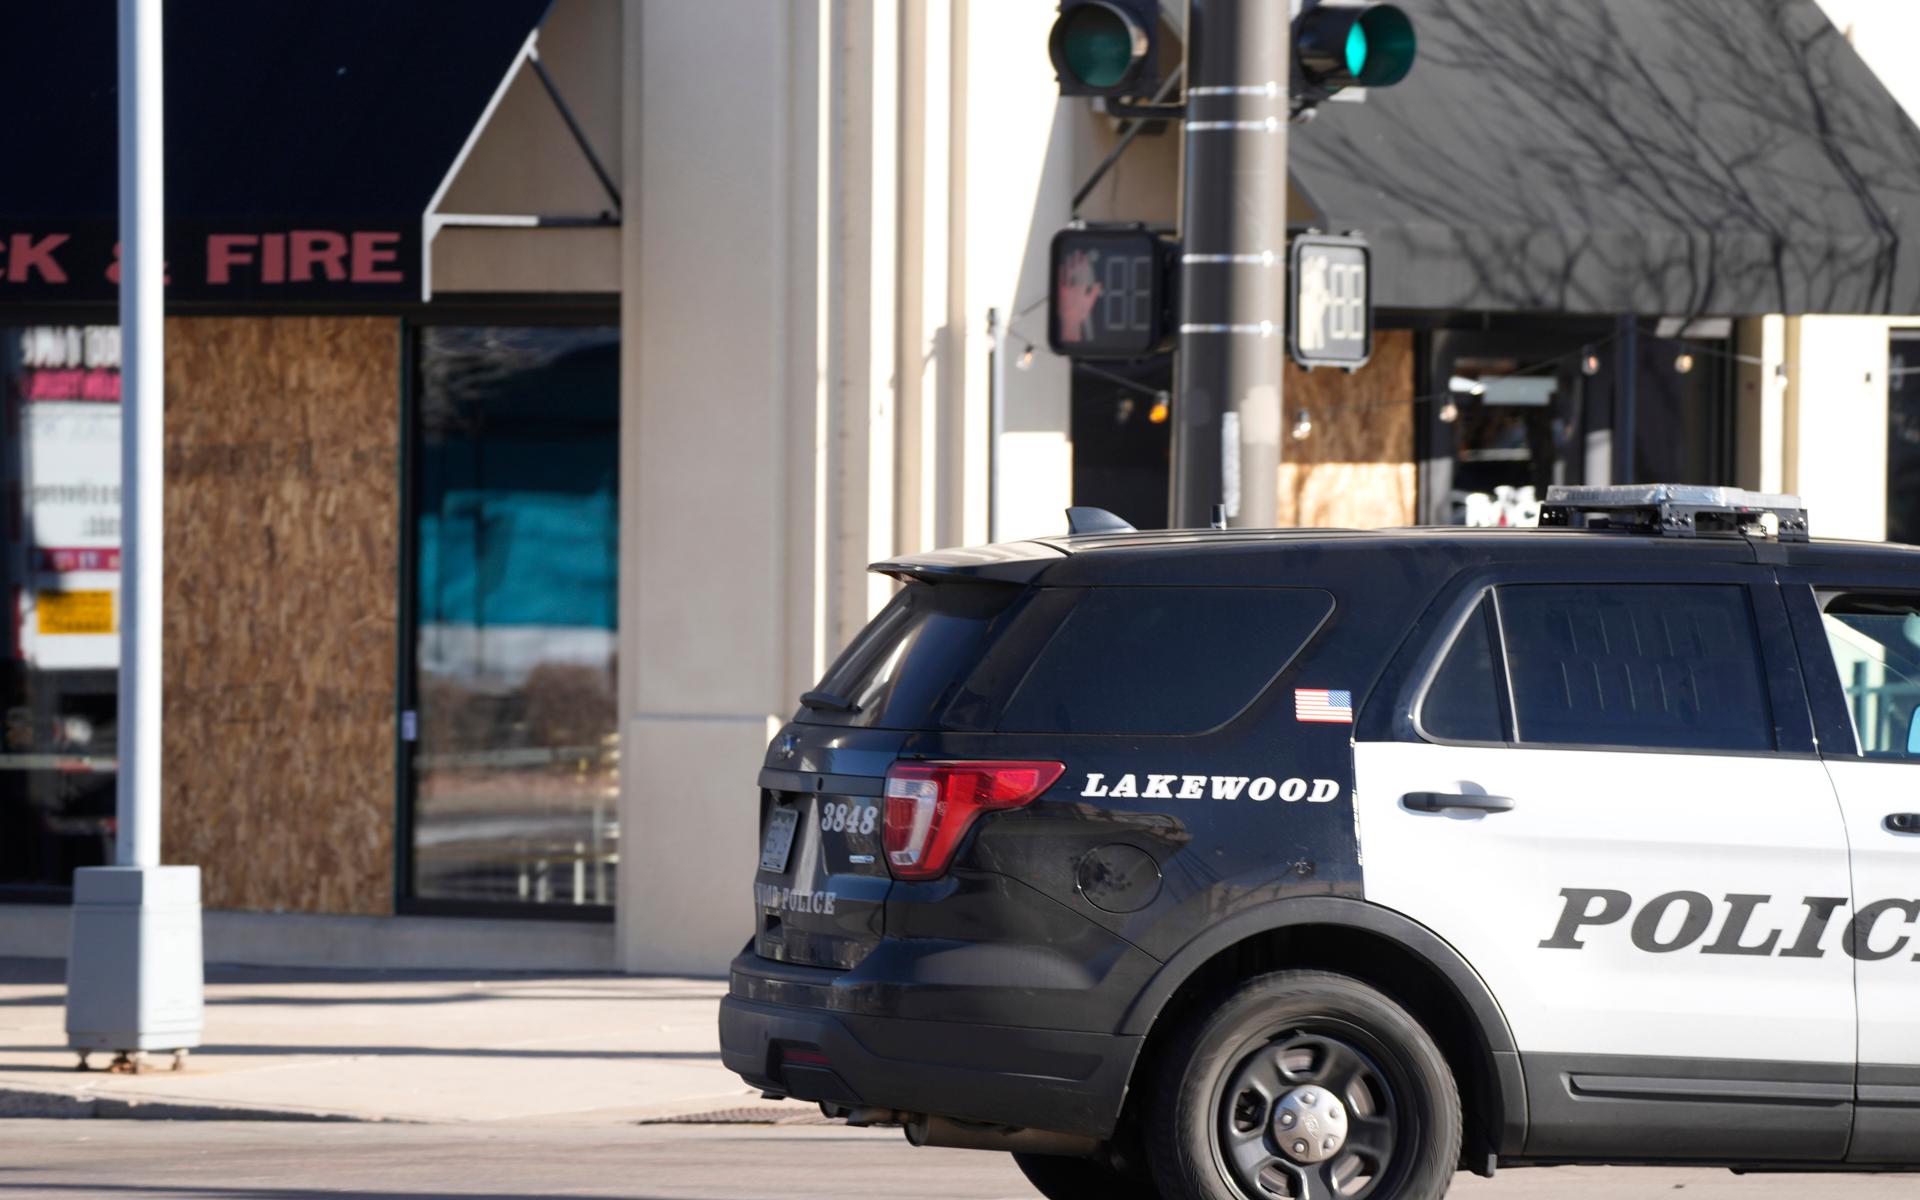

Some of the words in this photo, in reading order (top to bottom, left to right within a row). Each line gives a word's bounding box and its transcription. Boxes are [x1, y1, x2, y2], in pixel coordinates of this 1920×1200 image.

[0, 232, 71, 283] K
[207, 230, 404, 284] FIRE
[1080, 773, 1340, 803] LAKEWOOD
[822, 803, 878, 835] 3848
[782, 887, 836, 915] POLICE
[1537, 887, 1920, 962] POLIC
